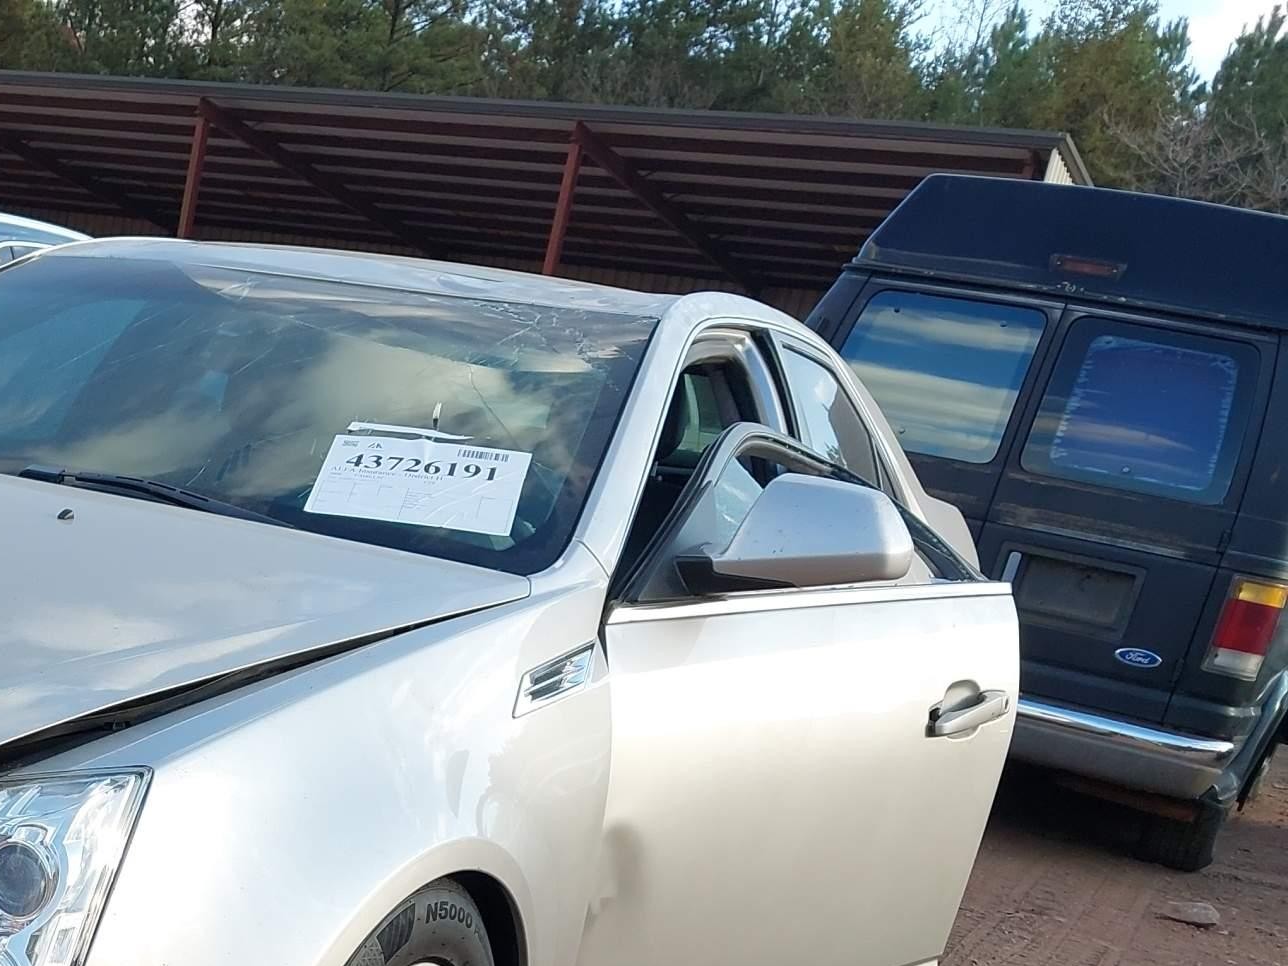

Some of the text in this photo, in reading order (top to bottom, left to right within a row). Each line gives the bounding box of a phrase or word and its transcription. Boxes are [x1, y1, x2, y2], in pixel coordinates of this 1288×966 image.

[345, 453, 497, 481] 43726191
[1124, 651, 1151, 664] Ford
[425, 901, 473, 928] N5000
